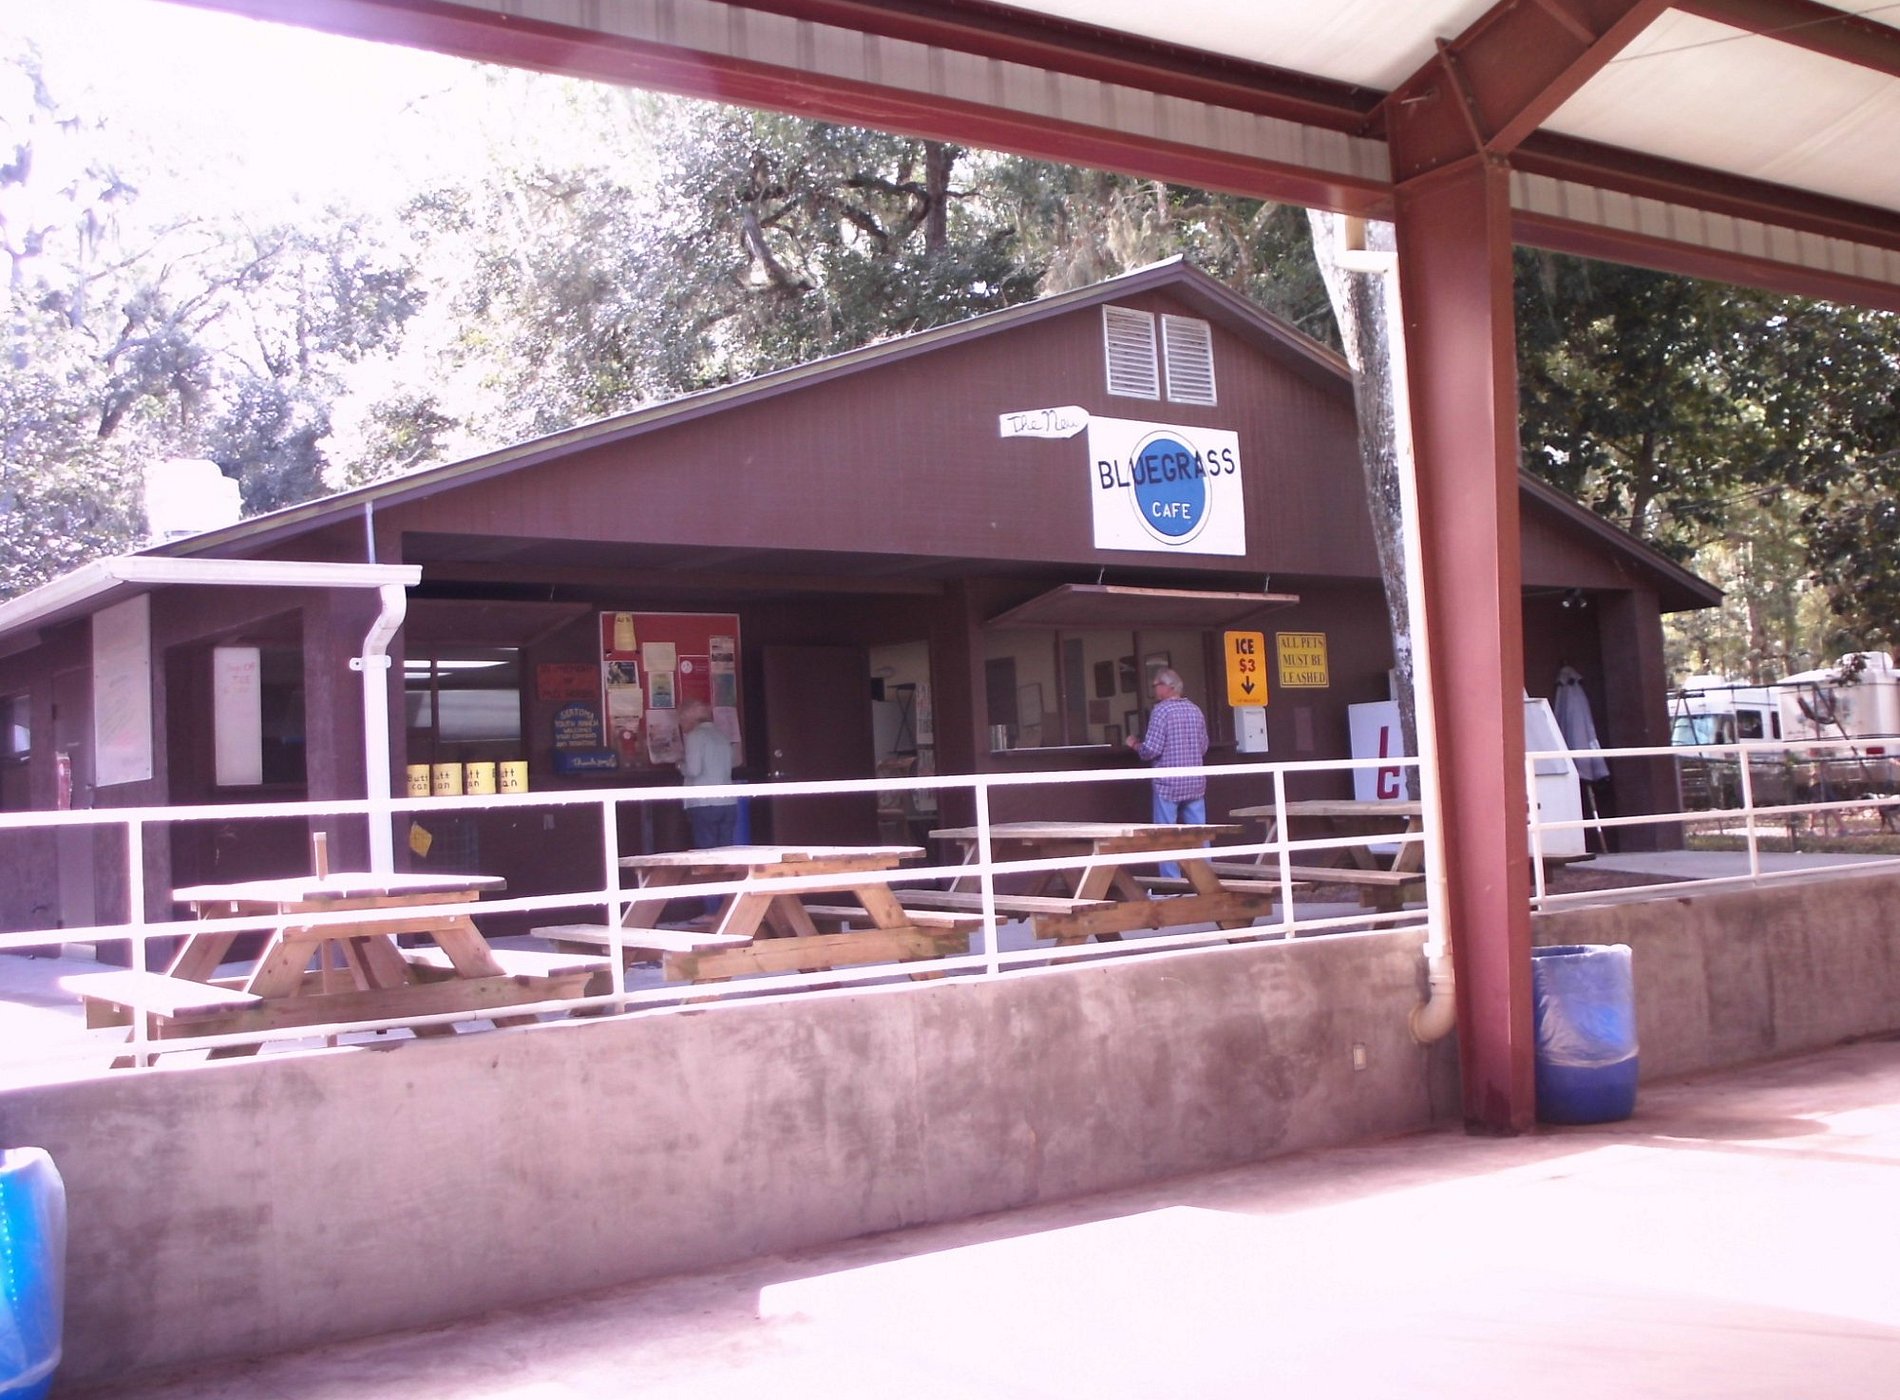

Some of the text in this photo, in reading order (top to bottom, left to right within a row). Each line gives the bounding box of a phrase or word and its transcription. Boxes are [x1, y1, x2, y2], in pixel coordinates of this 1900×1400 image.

[1097, 448, 1236, 490] BLUEGRASS
[1151, 501, 1192, 520] CAFE
[1235, 638, 1255, 655] ICE
[1281, 637, 1324, 649] ALL PETS
[1239, 658, 1256, 674] $3
[1282, 654, 1323, 666] MUST BE
[1283, 672, 1326, 683] LEASHED
